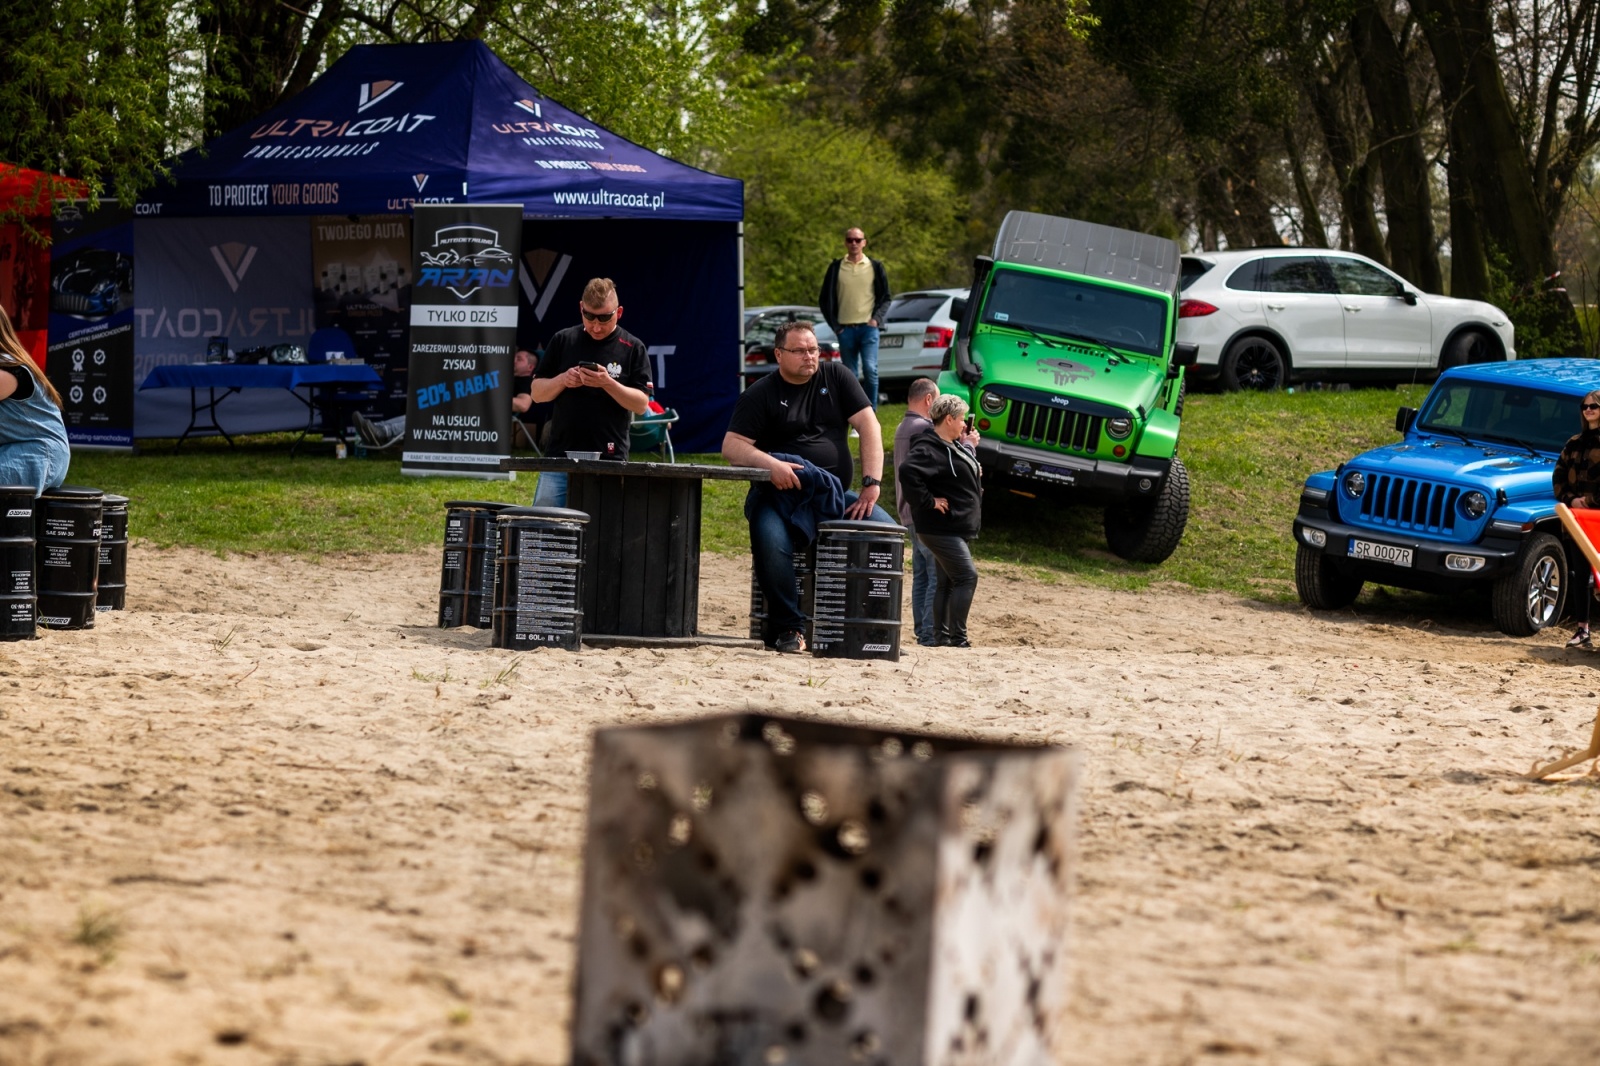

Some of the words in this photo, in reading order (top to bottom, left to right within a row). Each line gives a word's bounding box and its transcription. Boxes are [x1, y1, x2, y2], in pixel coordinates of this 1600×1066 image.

[250, 112, 436, 139] ULTRACOAT
[492, 122, 600, 140] ULTRACOAT
[243, 141, 380, 158] PROFESSIONALS
[534, 160, 550, 169] TO
[550, 160, 591, 170] PROTECT
[208, 185, 222, 206] TO
[224, 184, 269, 205] PROTECT
[271, 184, 300, 204] YOUR
[302, 183, 339, 204] GOODS
[554, 190, 664, 210] www.ultracoat.pl
[318, 224, 371, 240] TWOJEGO
[374, 223, 405, 239] AUTA
[416, 268, 514, 287] ARAN
[427, 310, 466, 322] TYLKO
[470, 308, 498, 322] DZIŚ
[412, 344, 456, 354] ZAREZERWUJ
[458, 344, 477, 354] SWÓJ
[479, 345, 505, 354] TERMIN
[443, 359, 476, 370] ZYSKAJ
[416, 383, 451, 410] 20%
[454, 370, 500, 399] RABAT
[1051, 396, 1069, 406] Jeep
[432, 415, 445, 425] NA
[447, 416, 480, 427] USŁUGI
[413, 429, 422, 439] W
[424, 430, 461, 440] NASZYM
[464, 430, 498, 442] STUDIO
[1356, 542, 1370, 555] SR
[1374, 545, 1410, 562] 0007R
